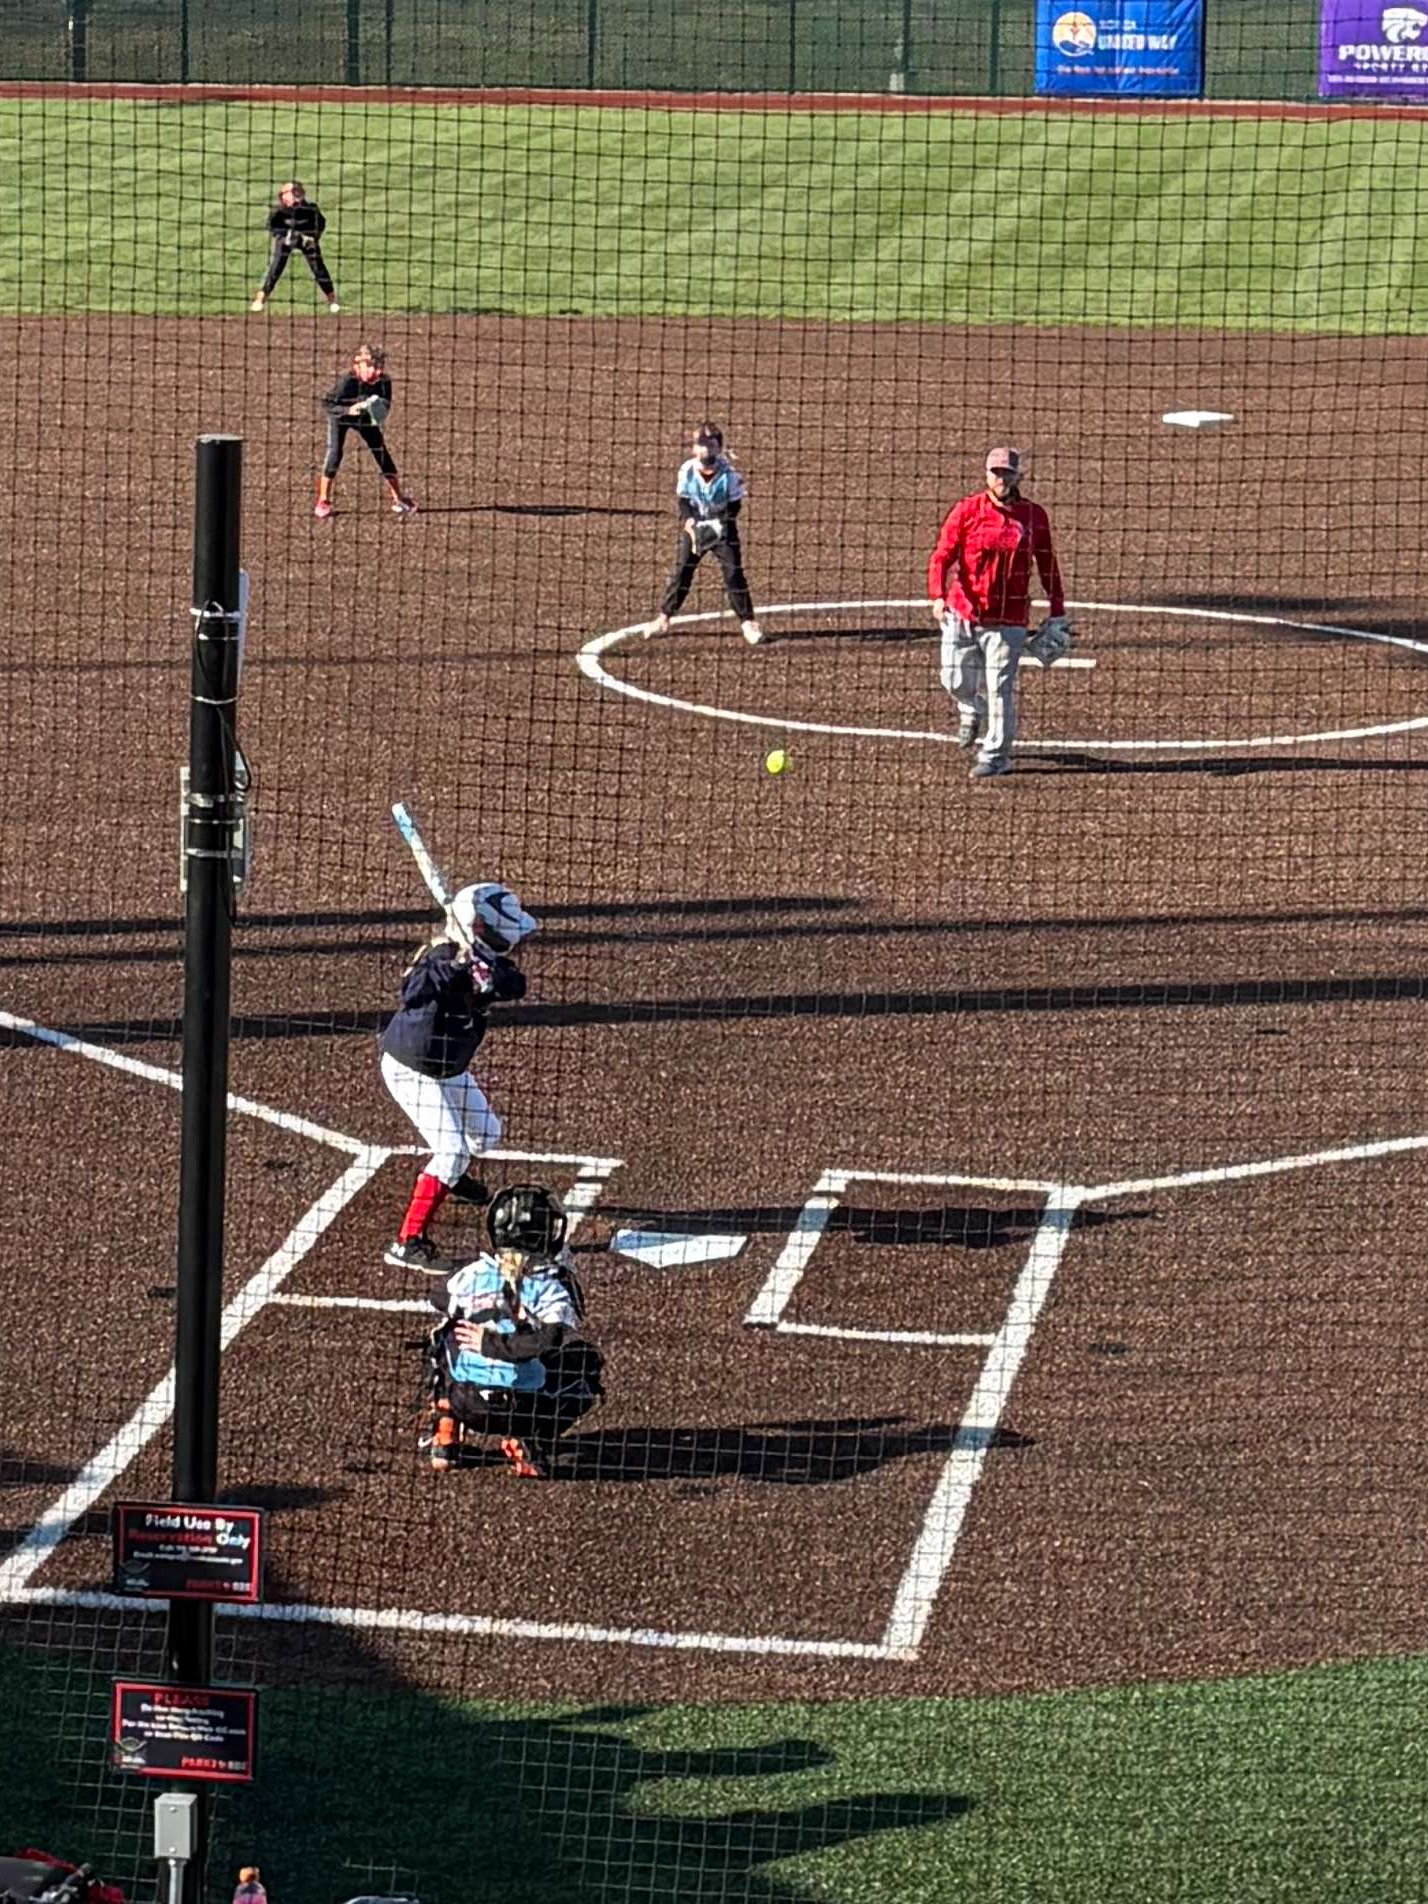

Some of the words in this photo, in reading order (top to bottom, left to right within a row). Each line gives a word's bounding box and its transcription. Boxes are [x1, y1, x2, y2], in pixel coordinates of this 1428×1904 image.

[145, 1512, 180, 1528] Field
[183, 1516, 211, 1530] Use
[215, 1517, 234, 1534] By
[215, 1533, 251, 1549] Only
[154, 1693, 210, 1706] PLEASE
